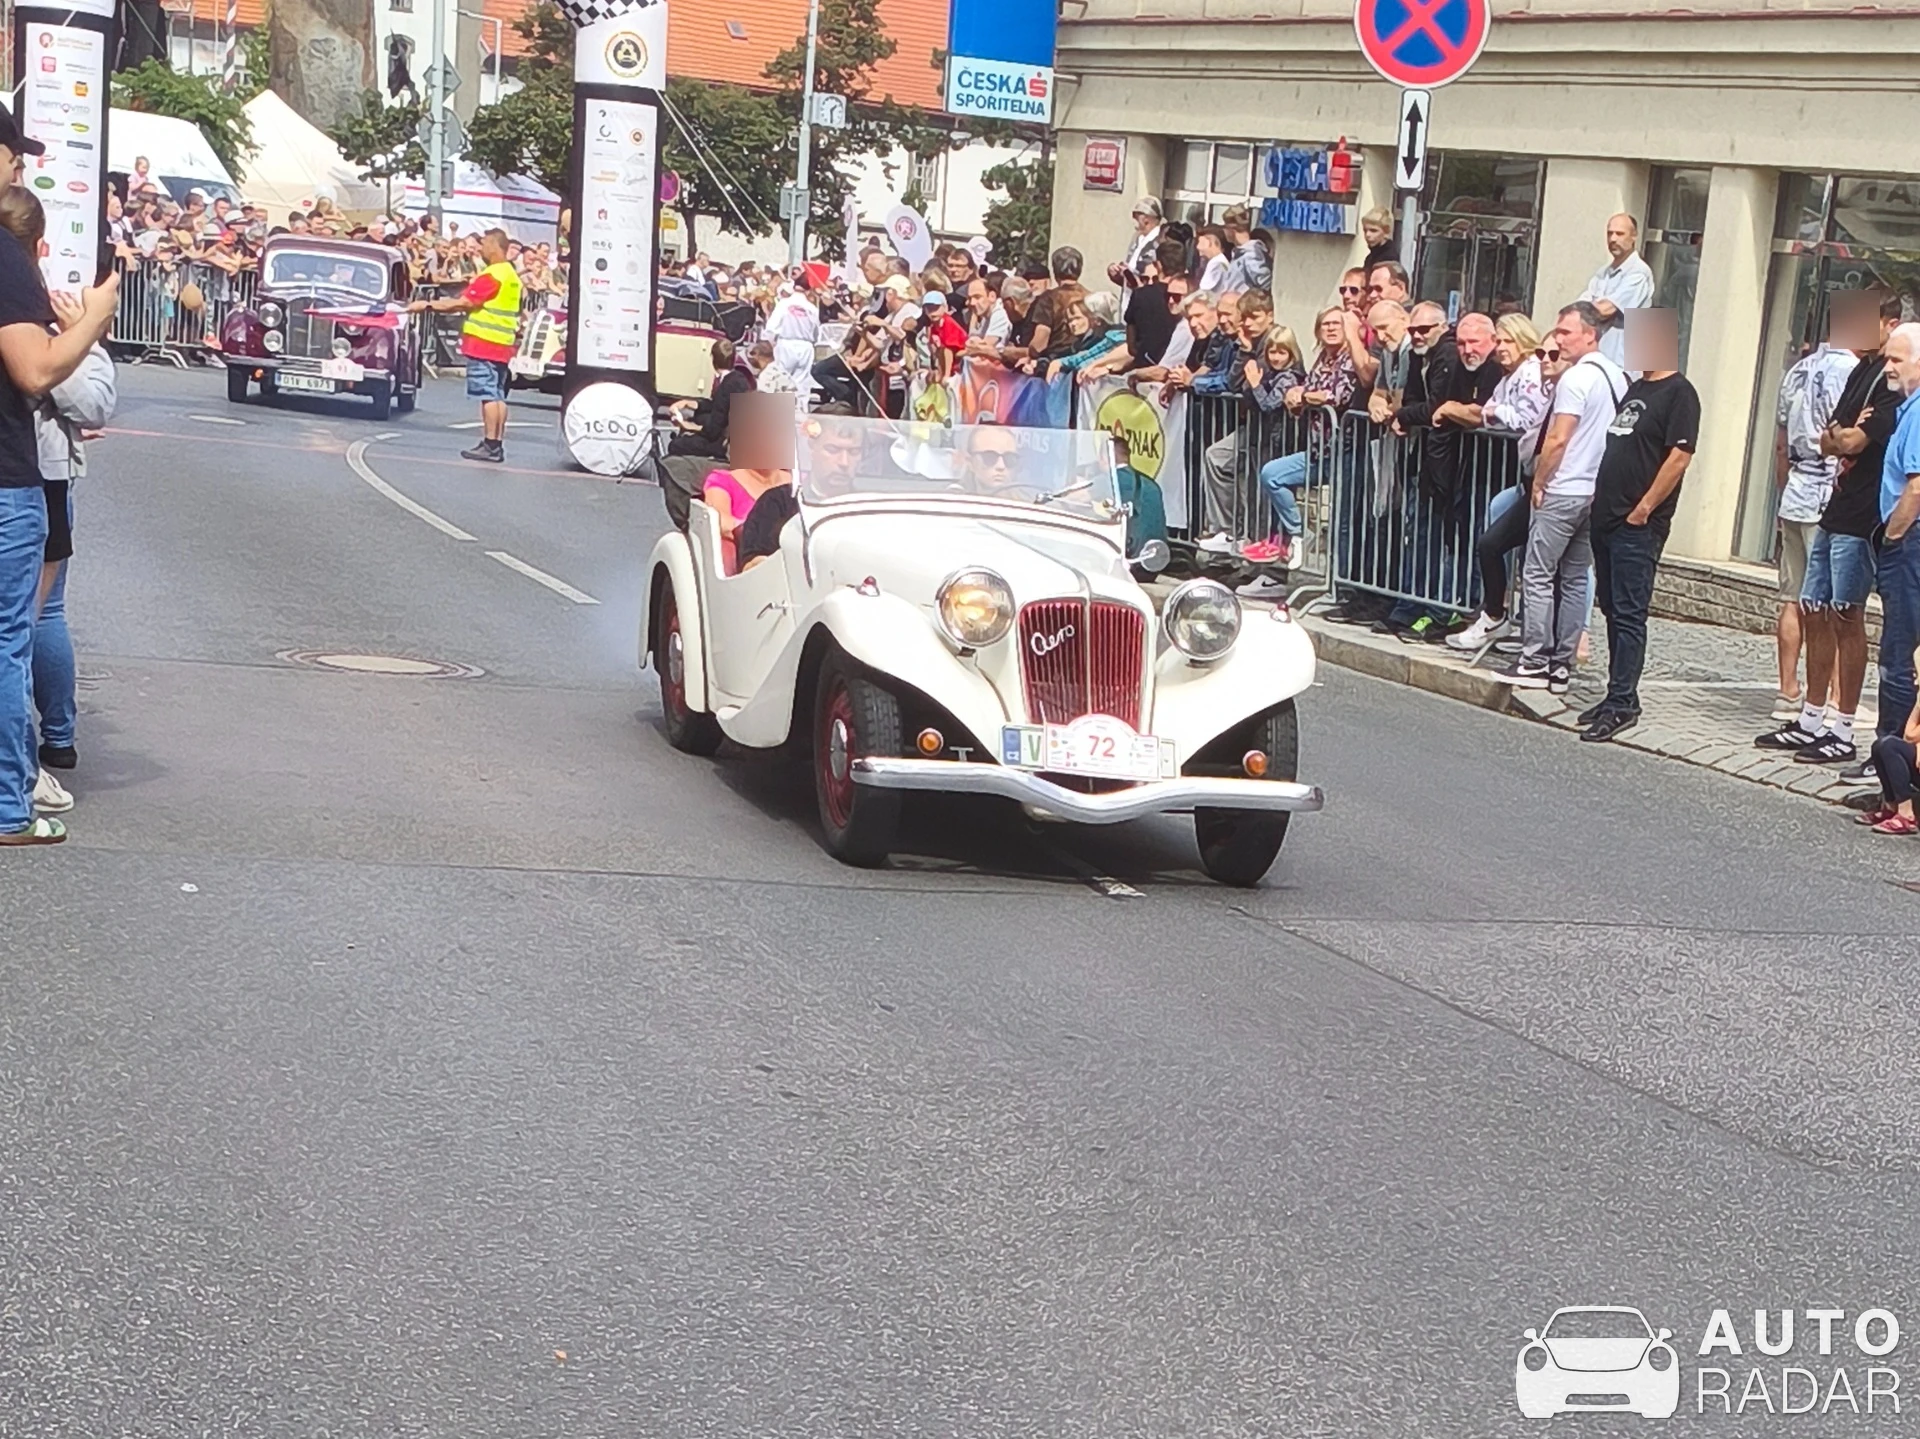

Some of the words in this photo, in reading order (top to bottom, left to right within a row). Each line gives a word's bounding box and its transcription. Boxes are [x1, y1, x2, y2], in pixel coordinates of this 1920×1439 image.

[958, 65, 1027, 95] ČESKÁ
[955, 92, 1045, 116] SPOŘITELNA
[1028, 734, 1042, 761] V
[1088, 735, 1116, 758] 72
